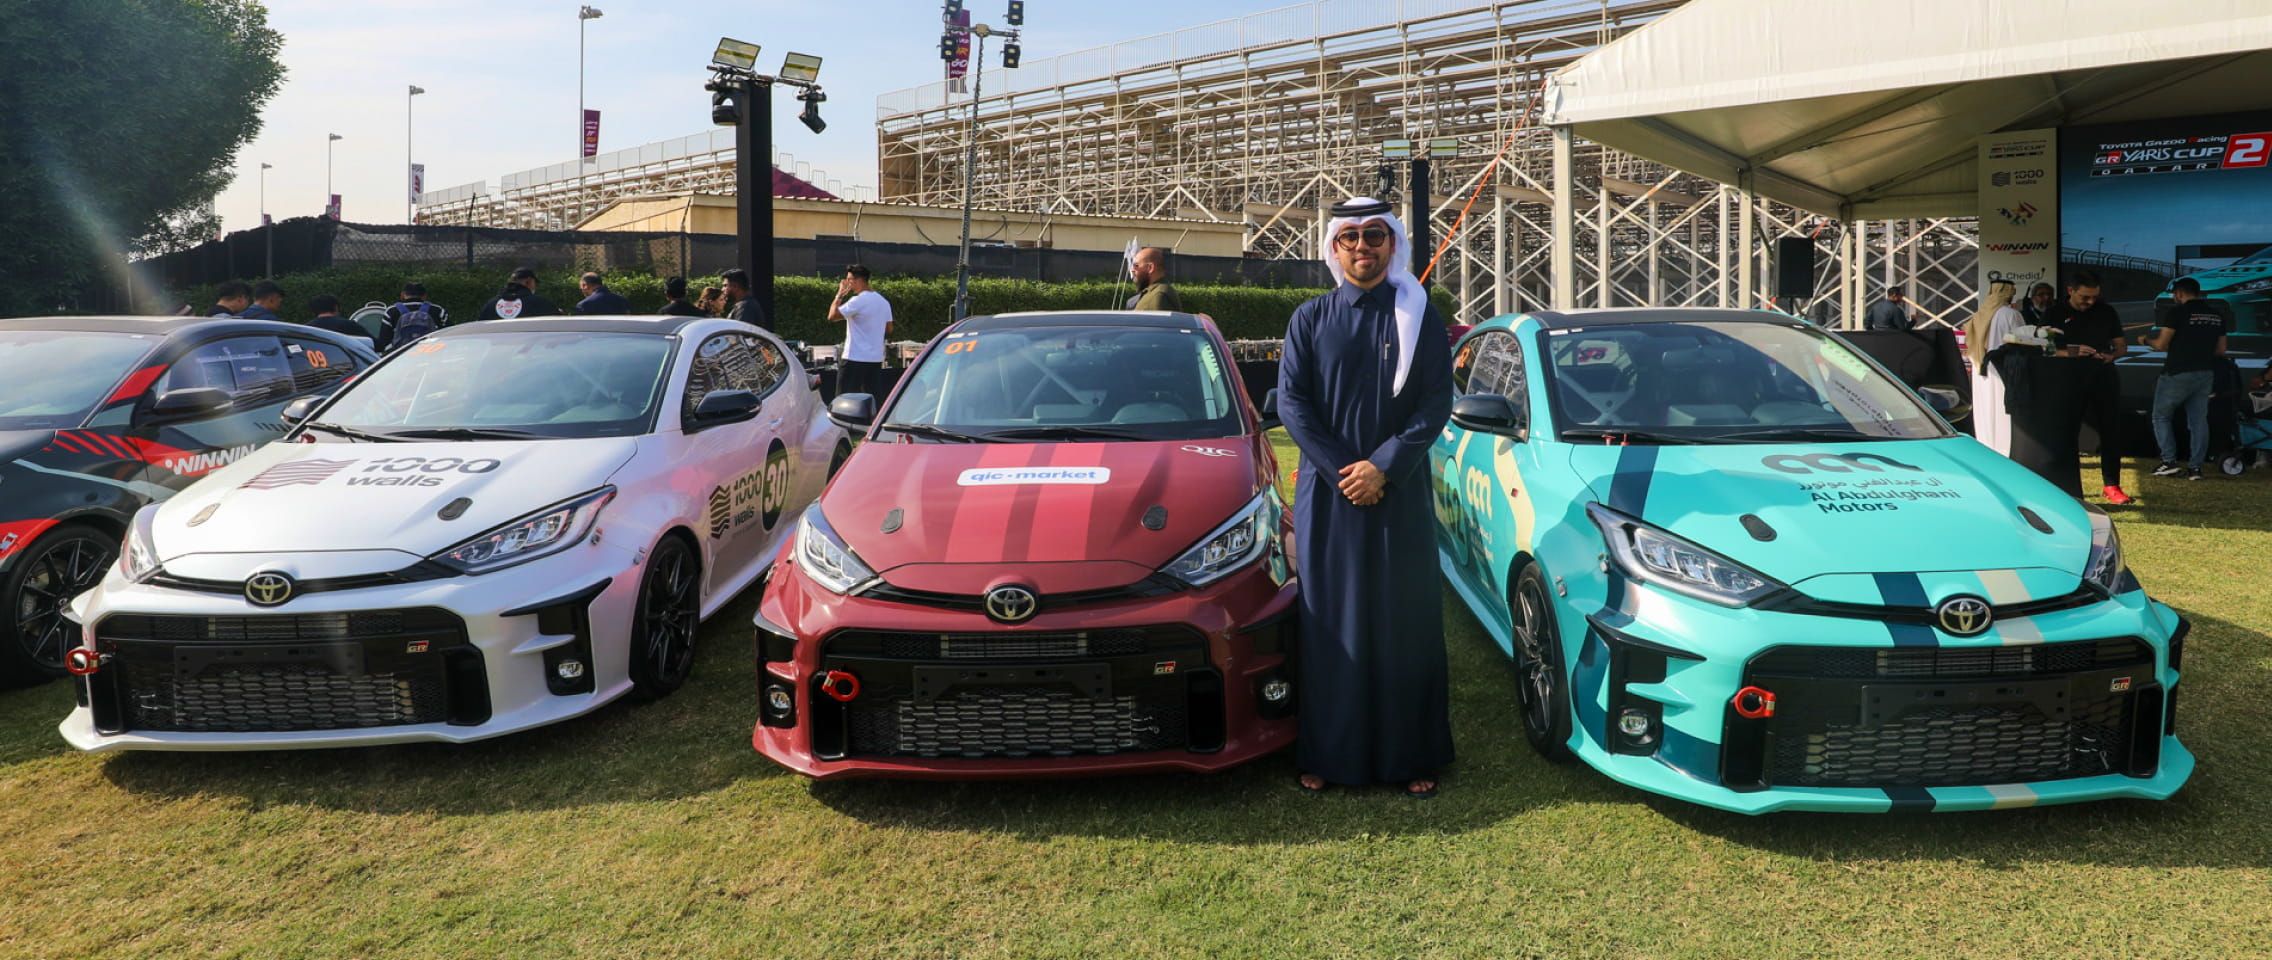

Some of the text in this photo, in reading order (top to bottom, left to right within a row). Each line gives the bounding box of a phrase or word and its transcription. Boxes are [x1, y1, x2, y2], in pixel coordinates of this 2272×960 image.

[2173, 146, 2225, 159] CUP
[2229, 138, 2265, 163] 2
[944, 340, 977, 355] 01
[306, 349, 328, 368] 09
[361, 457, 501, 474] 1000
[346, 475, 444, 487] walls
[733, 469, 762, 507] 1000
[764, 459, 788, 513] 30
[1811, 488, 1961, 502] Al Abdulghani
[1817, 502, 1899, 514] Motors
